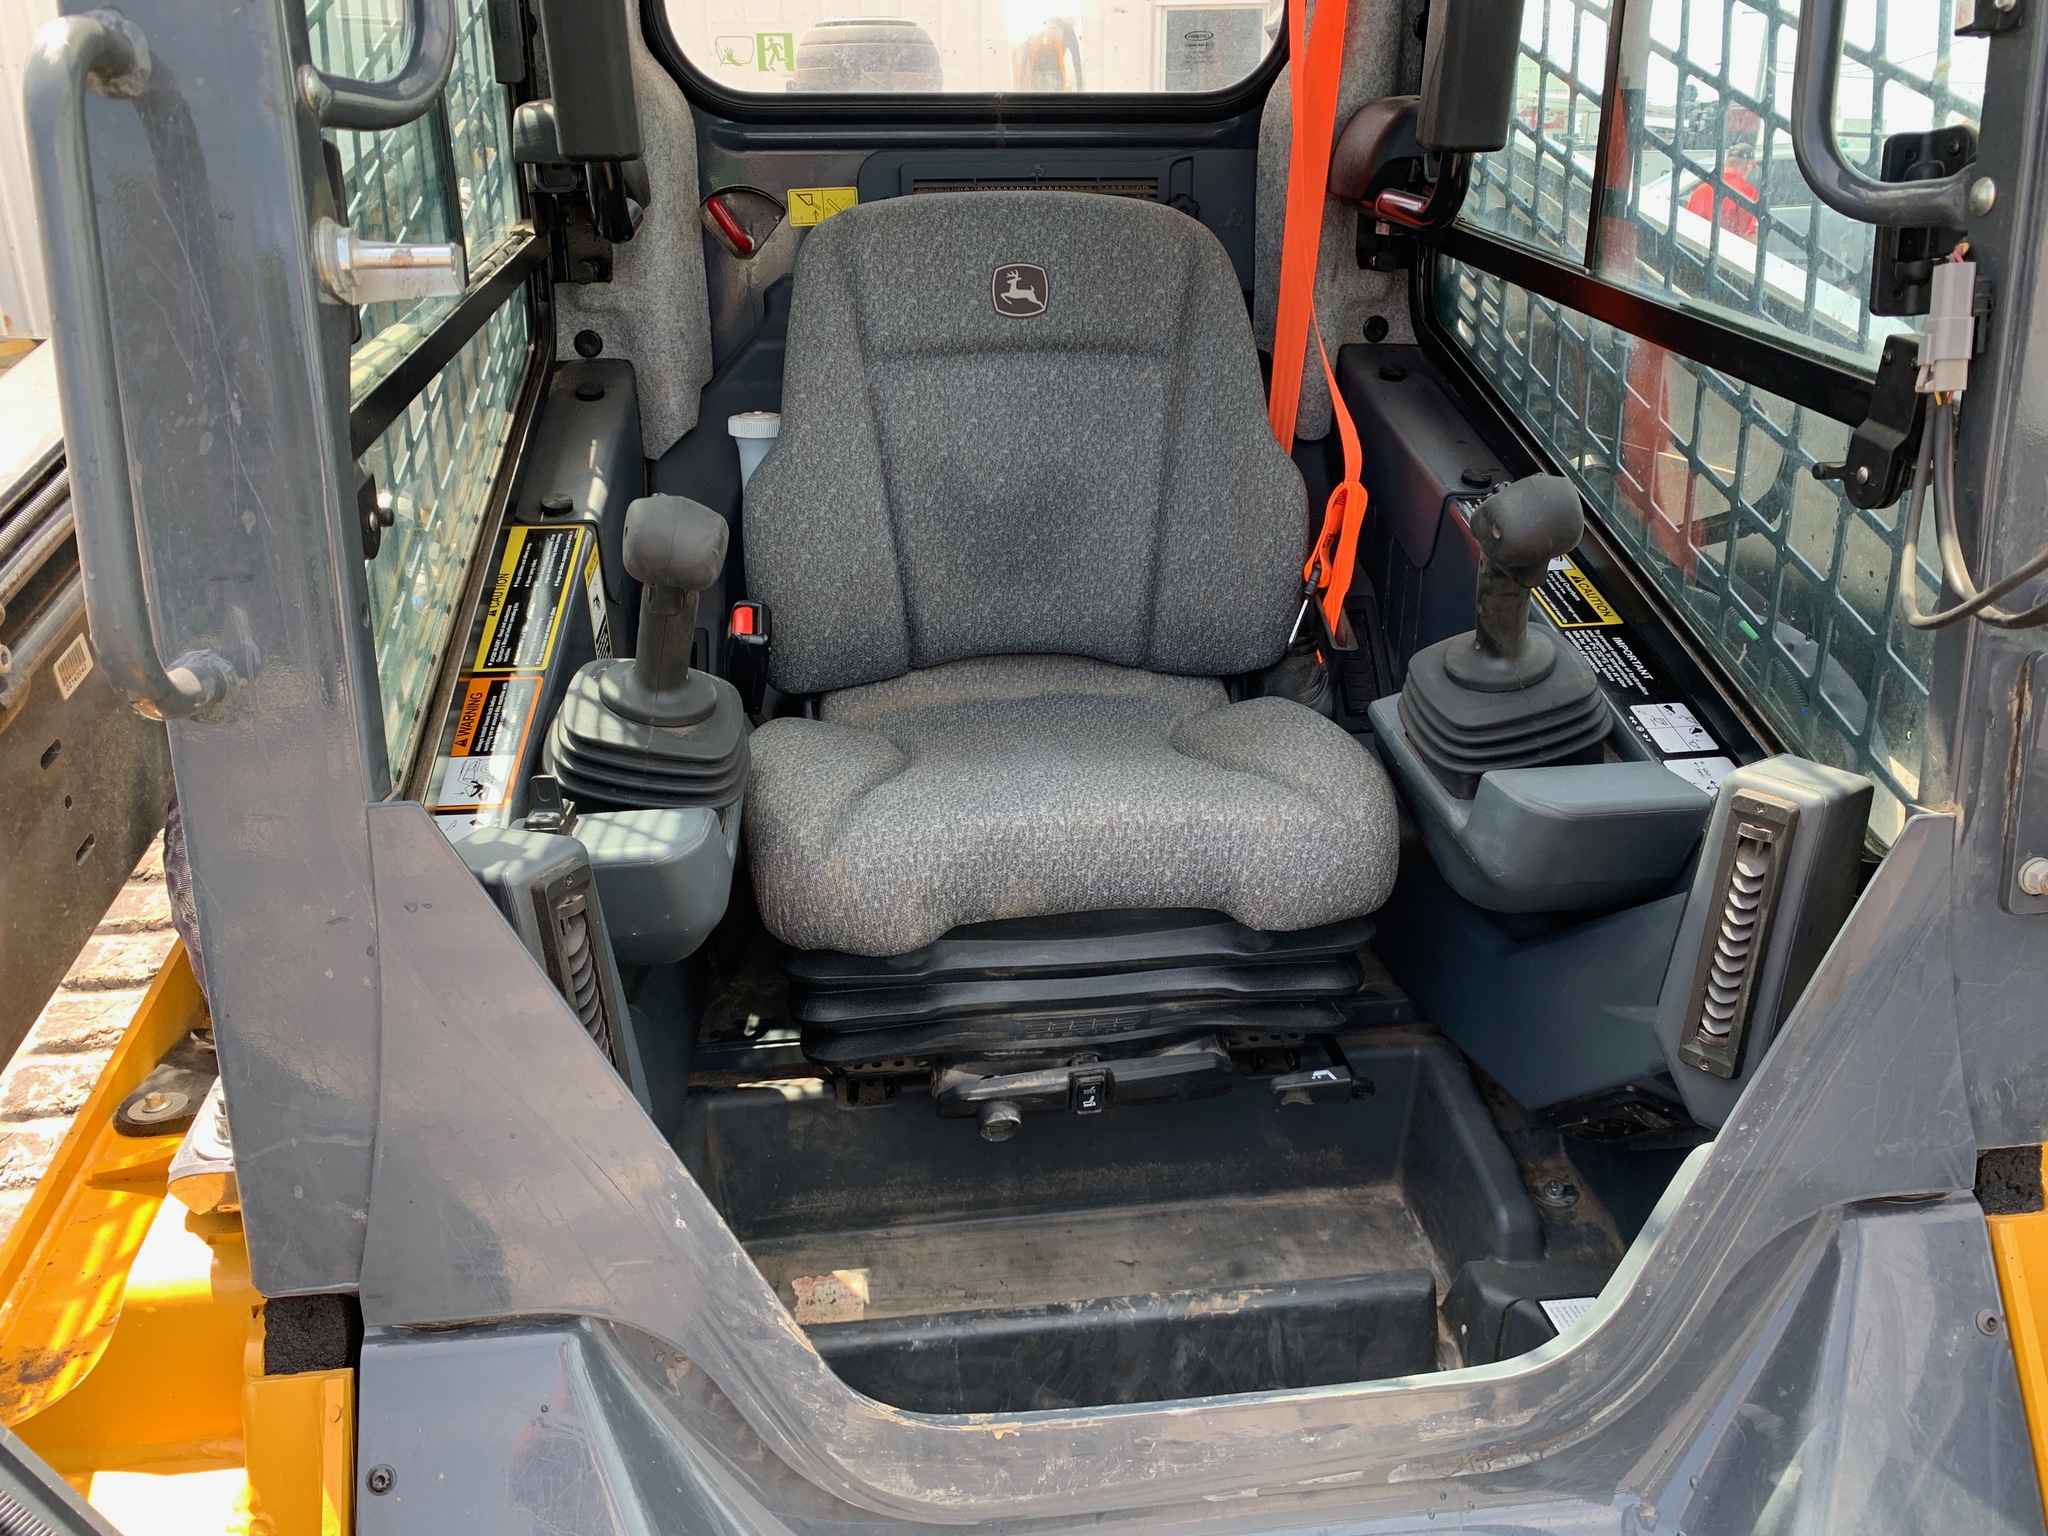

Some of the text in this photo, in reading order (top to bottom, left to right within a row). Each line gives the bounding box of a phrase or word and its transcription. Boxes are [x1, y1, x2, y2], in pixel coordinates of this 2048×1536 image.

[491, 572, 510, 608] CAUTION
[1553, 571, 1580, 601] Avoid Overturn
[1578, 583, 1613, 617] CAUTION
[1598, 635, 1613, 650] prevent
[1611, 651, 1626, 667] damage
[1612, 636, 1654, 681] IMPORTANT
[457, 692, 483, 736] WARNING
